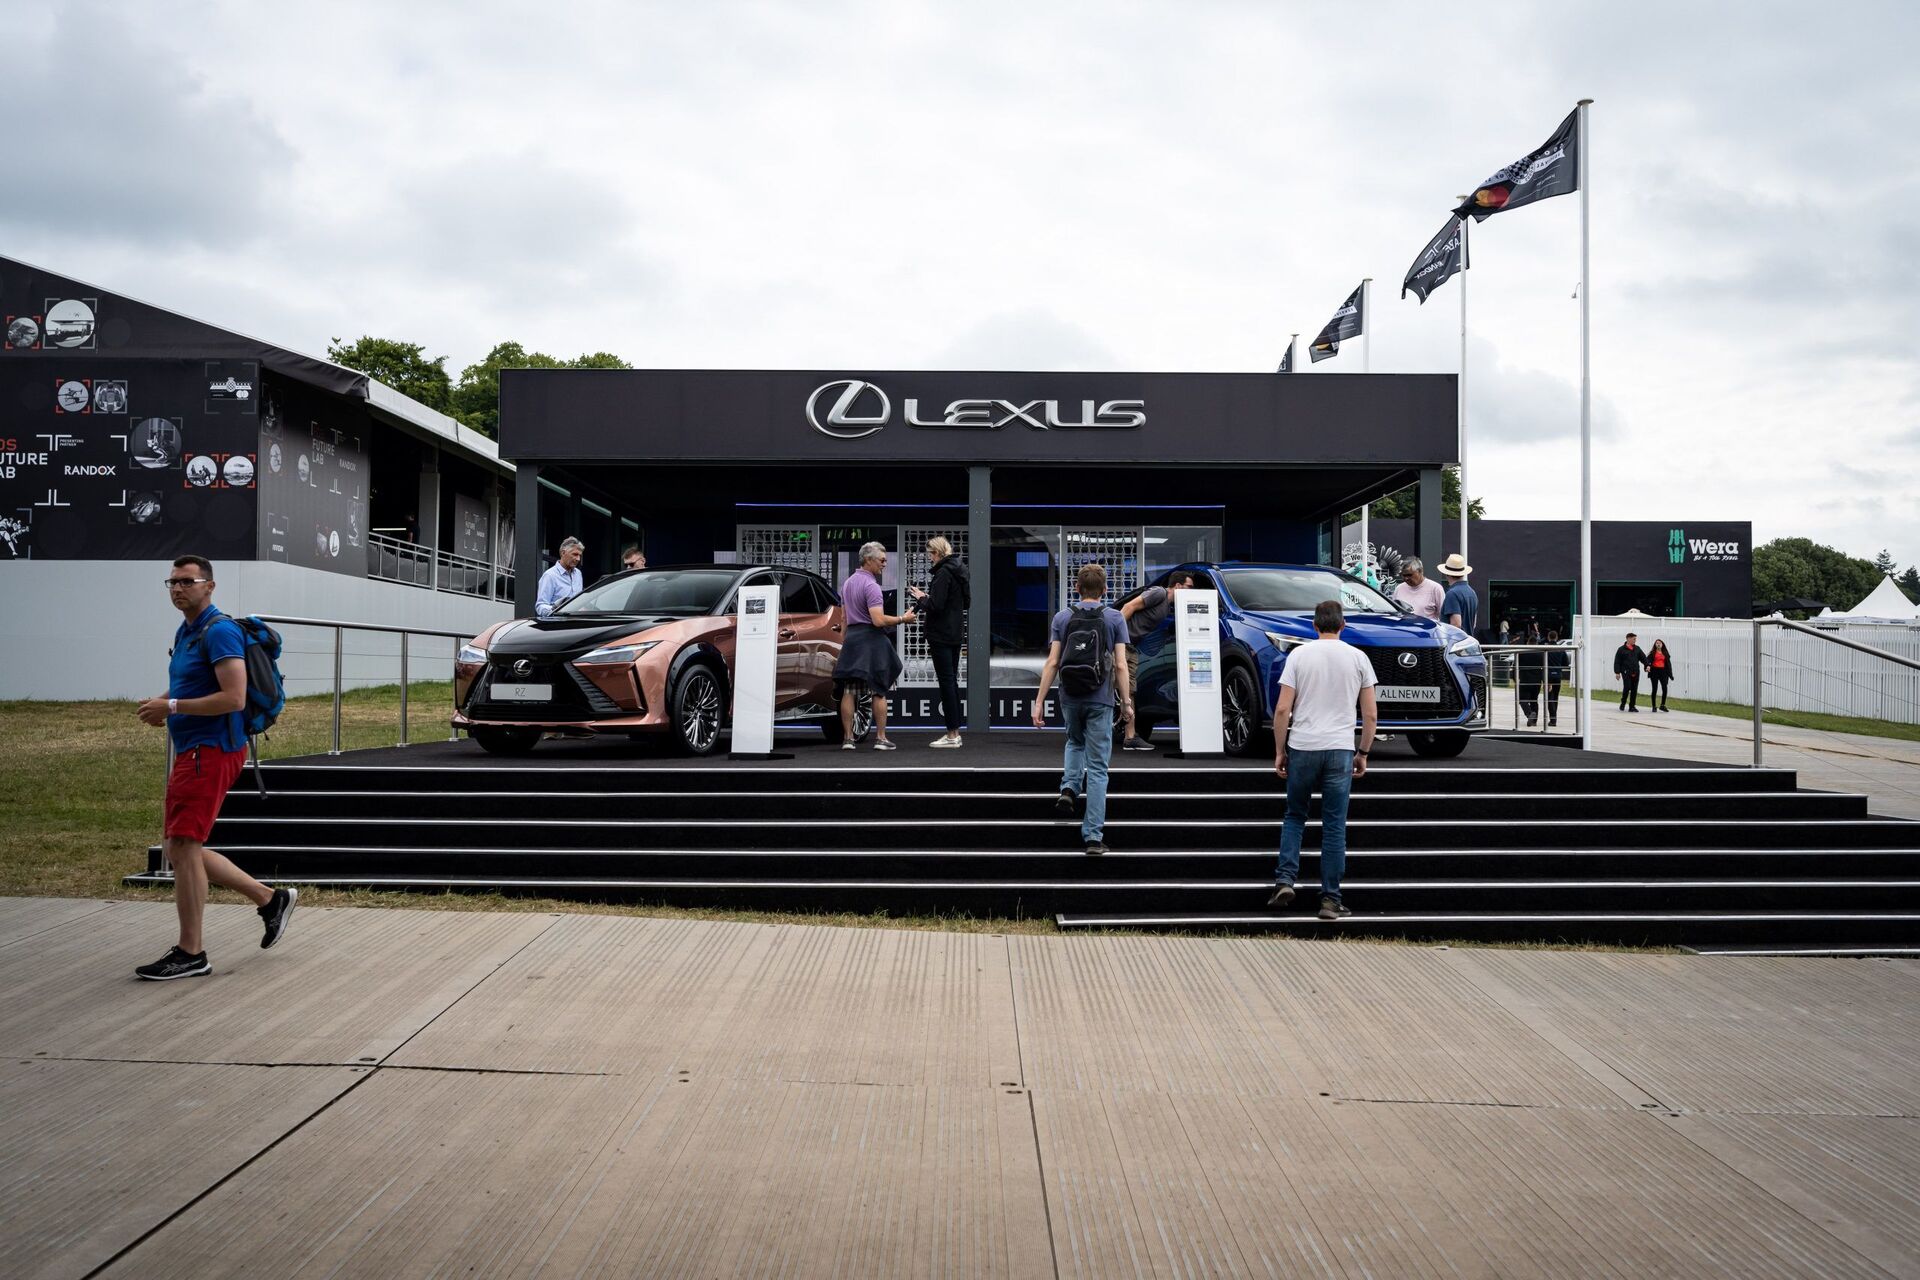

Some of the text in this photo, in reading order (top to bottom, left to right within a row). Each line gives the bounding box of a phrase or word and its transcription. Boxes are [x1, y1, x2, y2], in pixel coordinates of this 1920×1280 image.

[904, 398, 1147, 431] LEXUS
[64, 465, 116, 476] RANDOX
[1688, 538, 1739, 554] Wera
[515, 687, 526, 697] RZ
[1380, 689, 1436, 699] ALL NEW NX
